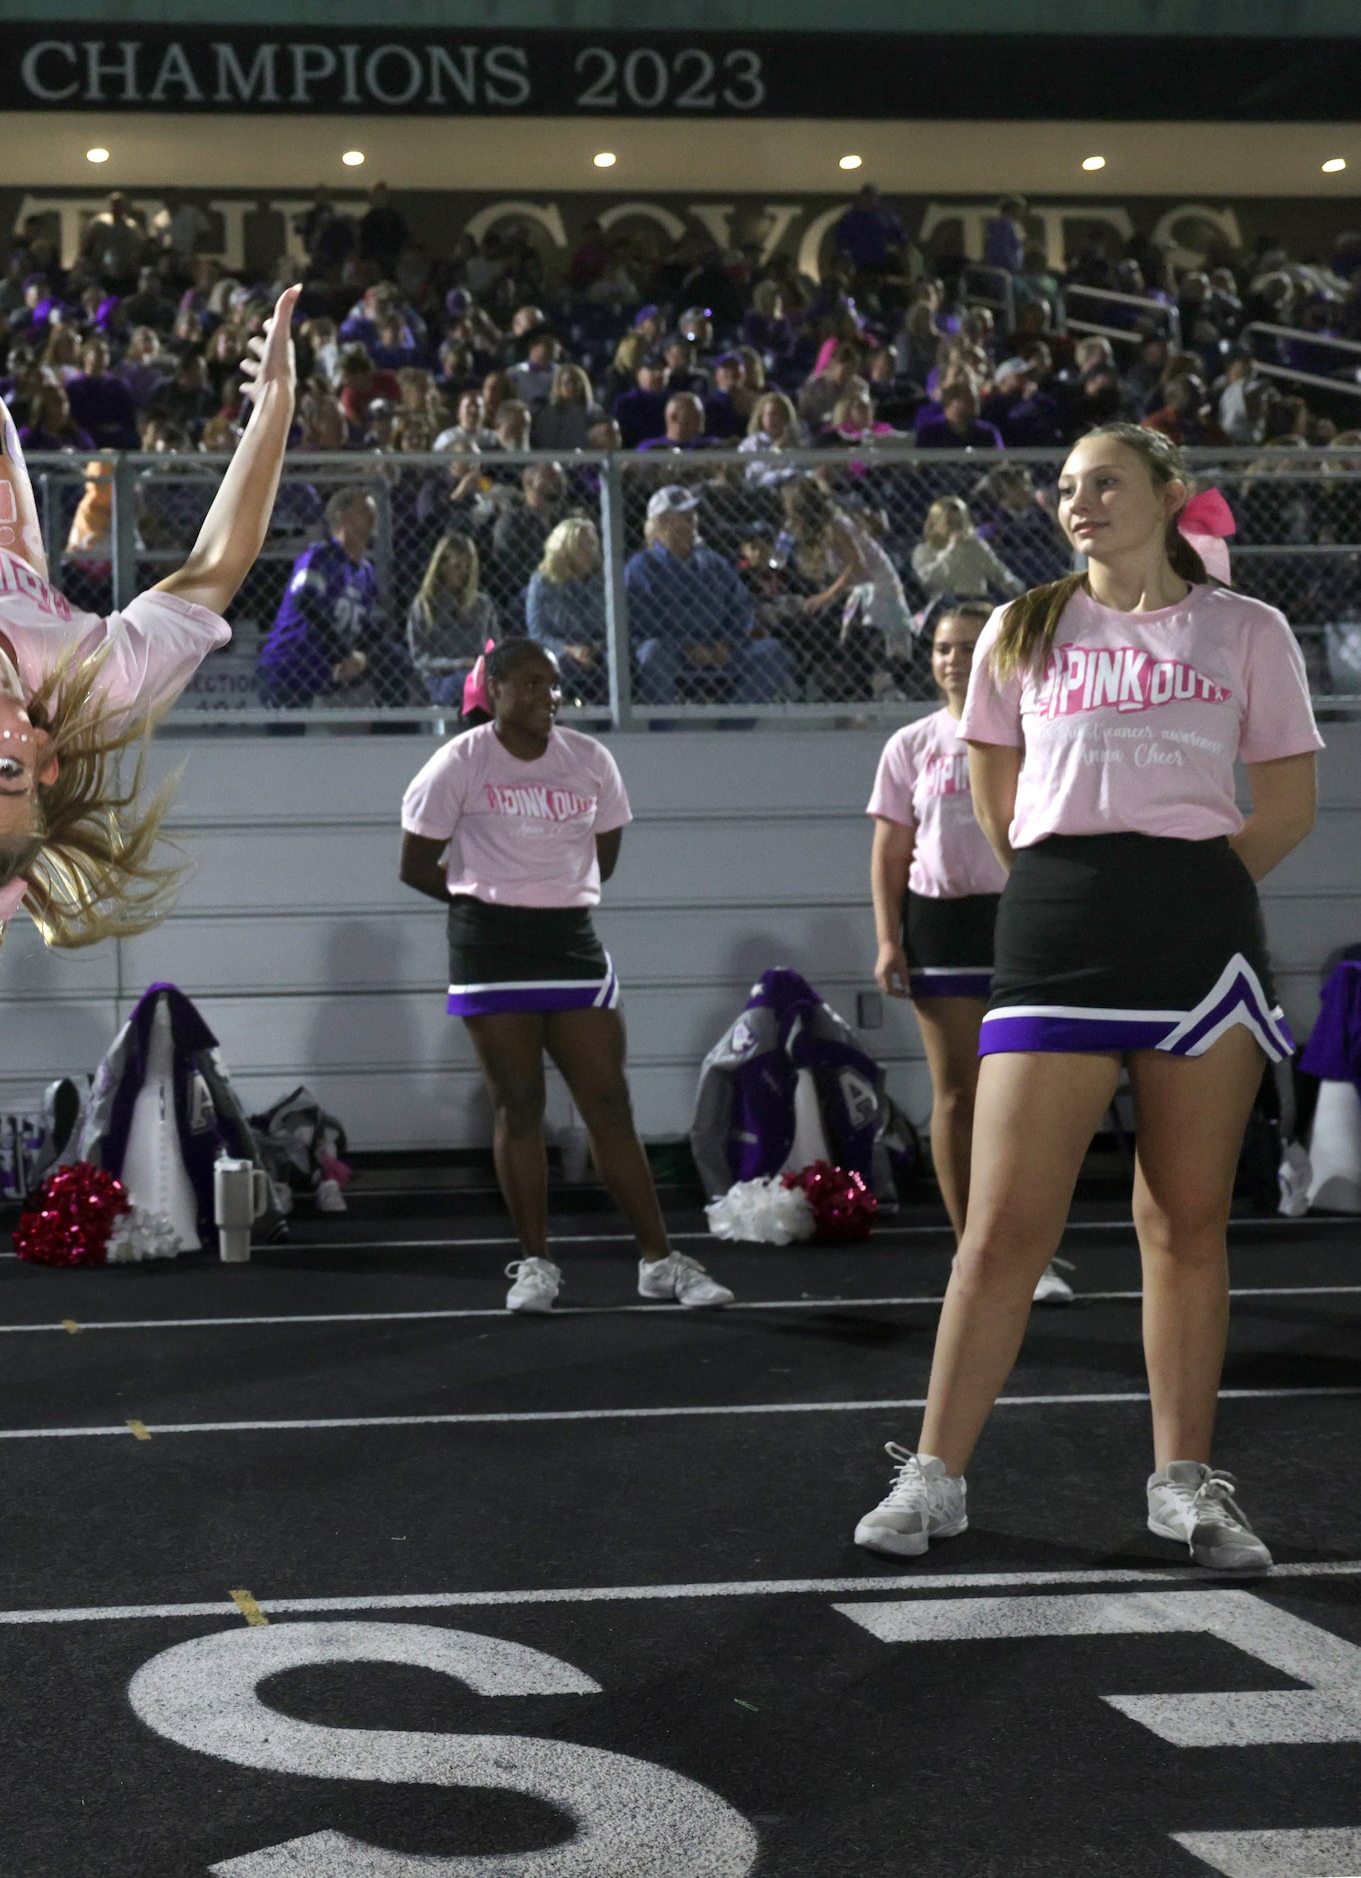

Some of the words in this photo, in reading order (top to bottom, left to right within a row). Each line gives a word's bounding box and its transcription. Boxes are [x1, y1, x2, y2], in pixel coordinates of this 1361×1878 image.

[21, 40, 533, 105] CHAMPIONS
[574, 47, 767, 110] 2023
[1058, 649, 1149, 713] PINK
[1150, 662, 1215, 705] OUT
[1107, 724, 1156, 740] cancer
[1133, 741, 1186, 769] Cheer
[501, 786, 555, 820] PINK
